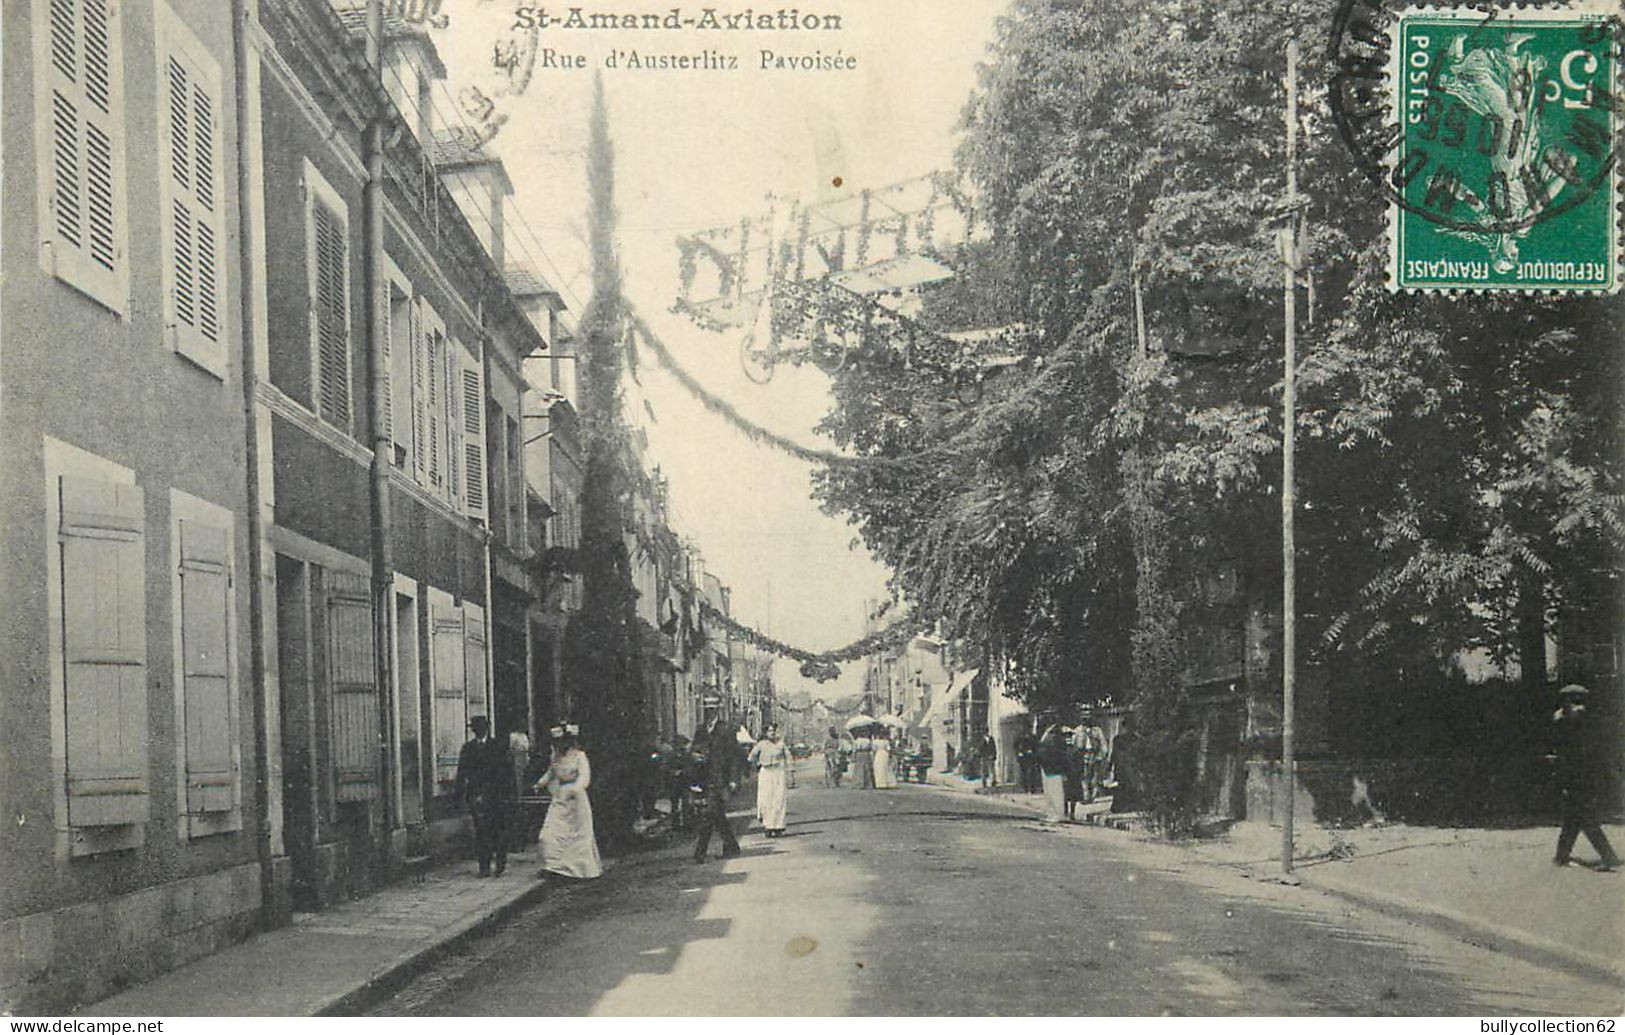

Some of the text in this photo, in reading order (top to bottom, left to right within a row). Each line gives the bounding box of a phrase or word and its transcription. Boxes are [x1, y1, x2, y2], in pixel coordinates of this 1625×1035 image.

[1408, 35, 1430, 124] POSTES
[1408, 261, 1605, 281] REPUBLIQUE FRANÇAISE
